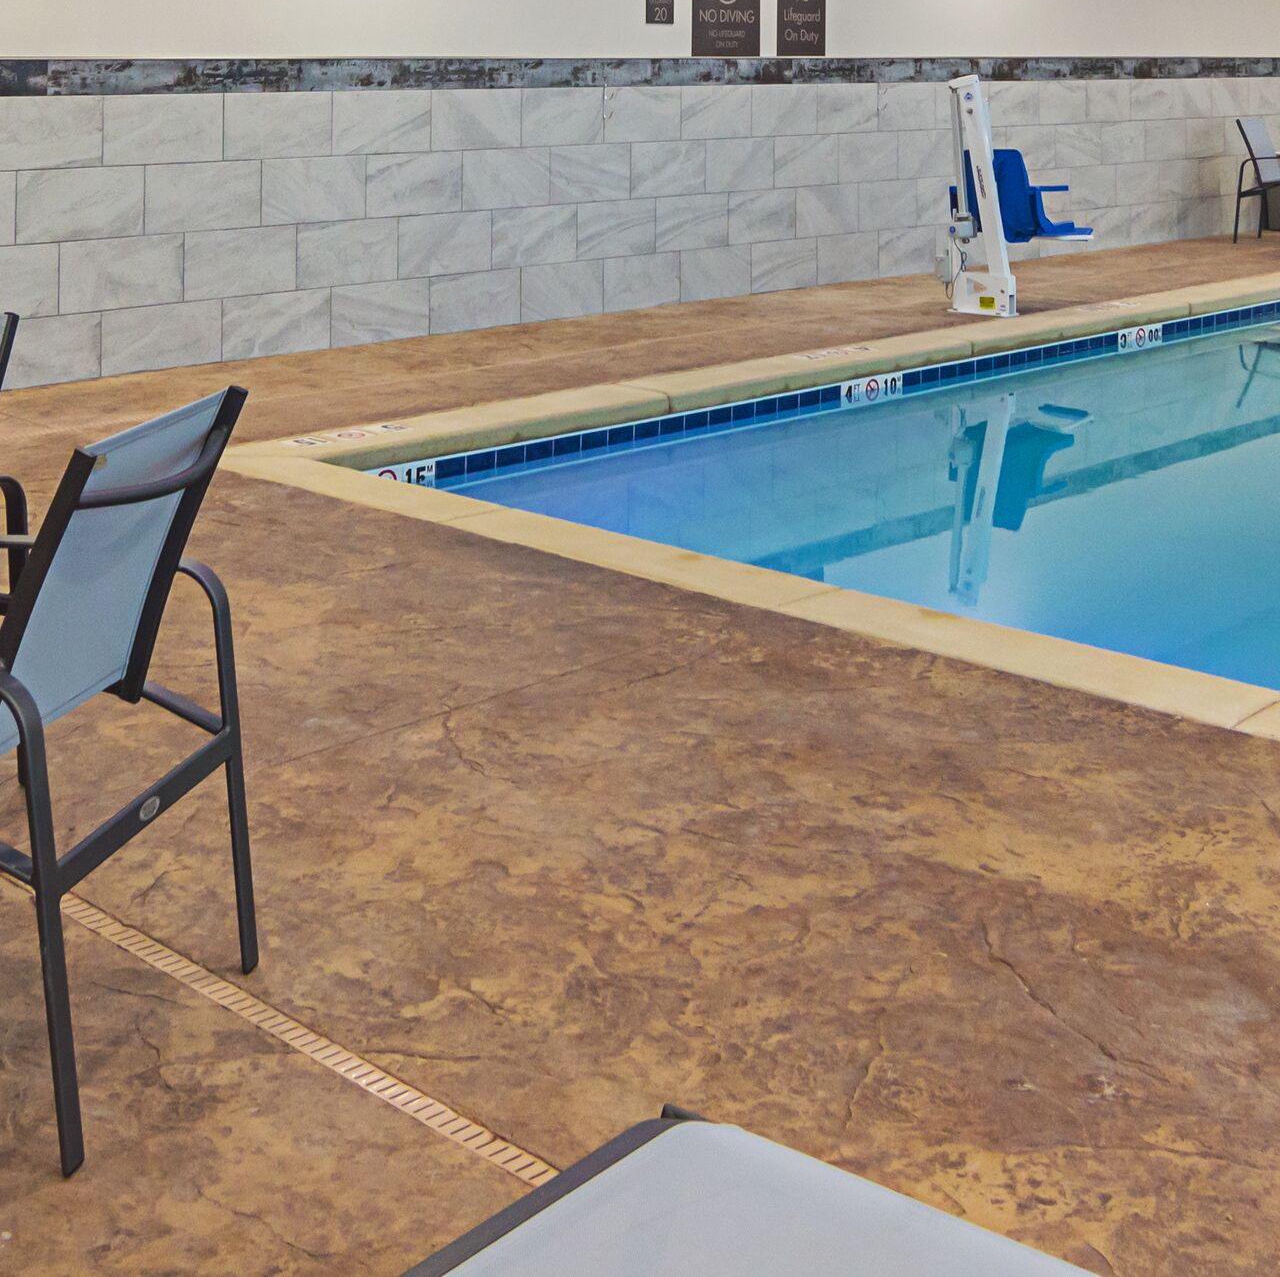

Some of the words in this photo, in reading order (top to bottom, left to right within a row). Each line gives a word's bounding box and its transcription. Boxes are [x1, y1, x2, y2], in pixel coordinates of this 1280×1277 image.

[654, 7, 668, 21] 20
[699, 9, 717, 23] NO
[719, 9, 755, 23] DIVING
[783, 7, 821, 25] Lifeguard
[784, 28, 798, 41] On
[800, 28, 819, 45] Duty
